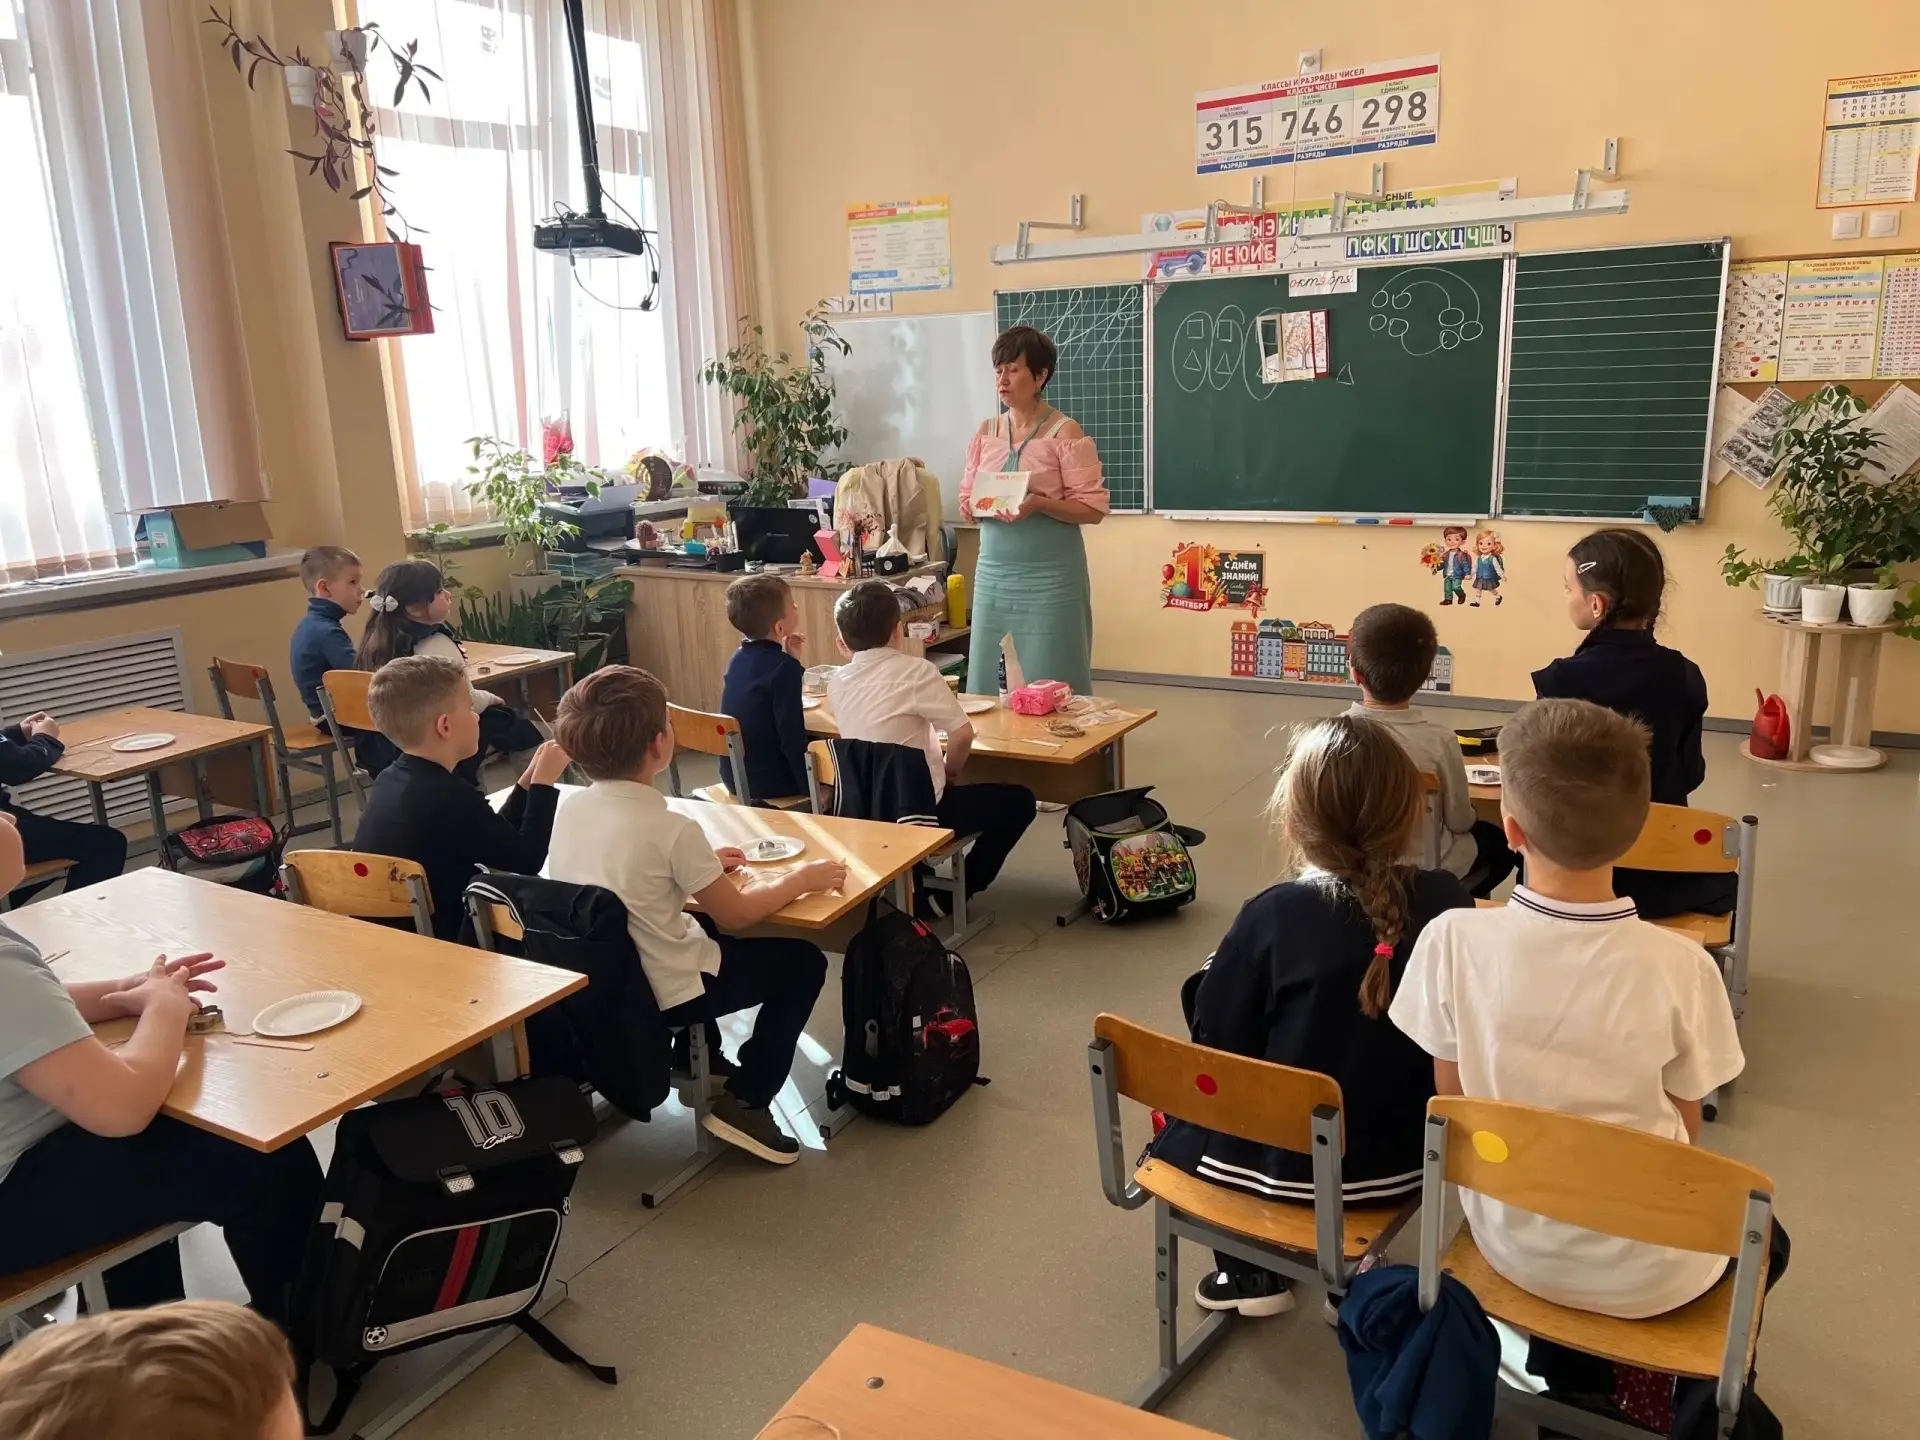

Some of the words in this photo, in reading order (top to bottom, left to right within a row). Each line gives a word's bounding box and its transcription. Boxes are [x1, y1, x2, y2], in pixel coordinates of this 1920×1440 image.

[1261, 80, 1292, 91] КЛАССЫ
[1300, 73, 1338, 85] РАЗРЯДЫ
[1339, 68, 1365, 79] ЧИСЕЛ
[1315, 82, 1338, 92] ЧИСЕЛ
[1361, 90, 1427, 130] 298
[1281, 104, 1343, 141] 746
[1205, 115, 1263, 151] 315
[1378, 139, 1409, 149] РАЗРЯДЫ
[1296, 150, 1326, 160] РАЗРЯДЫ
[1220, 161, 1248, 170] РАЗРЯДЫ
[1290, 270, 1354, 293] октября
[1174, 544, 1208, 601] 1
[1224, 561, 1230, 569] С
[1231, 560, 1257, 570] ДНЁМ
[1221, 572, 1259, 581] ЗНАНИЙ!
[1170, 597, 1209, 610] СЕНТЯБРЯ
[442, 1089, 526, 1148] 10
